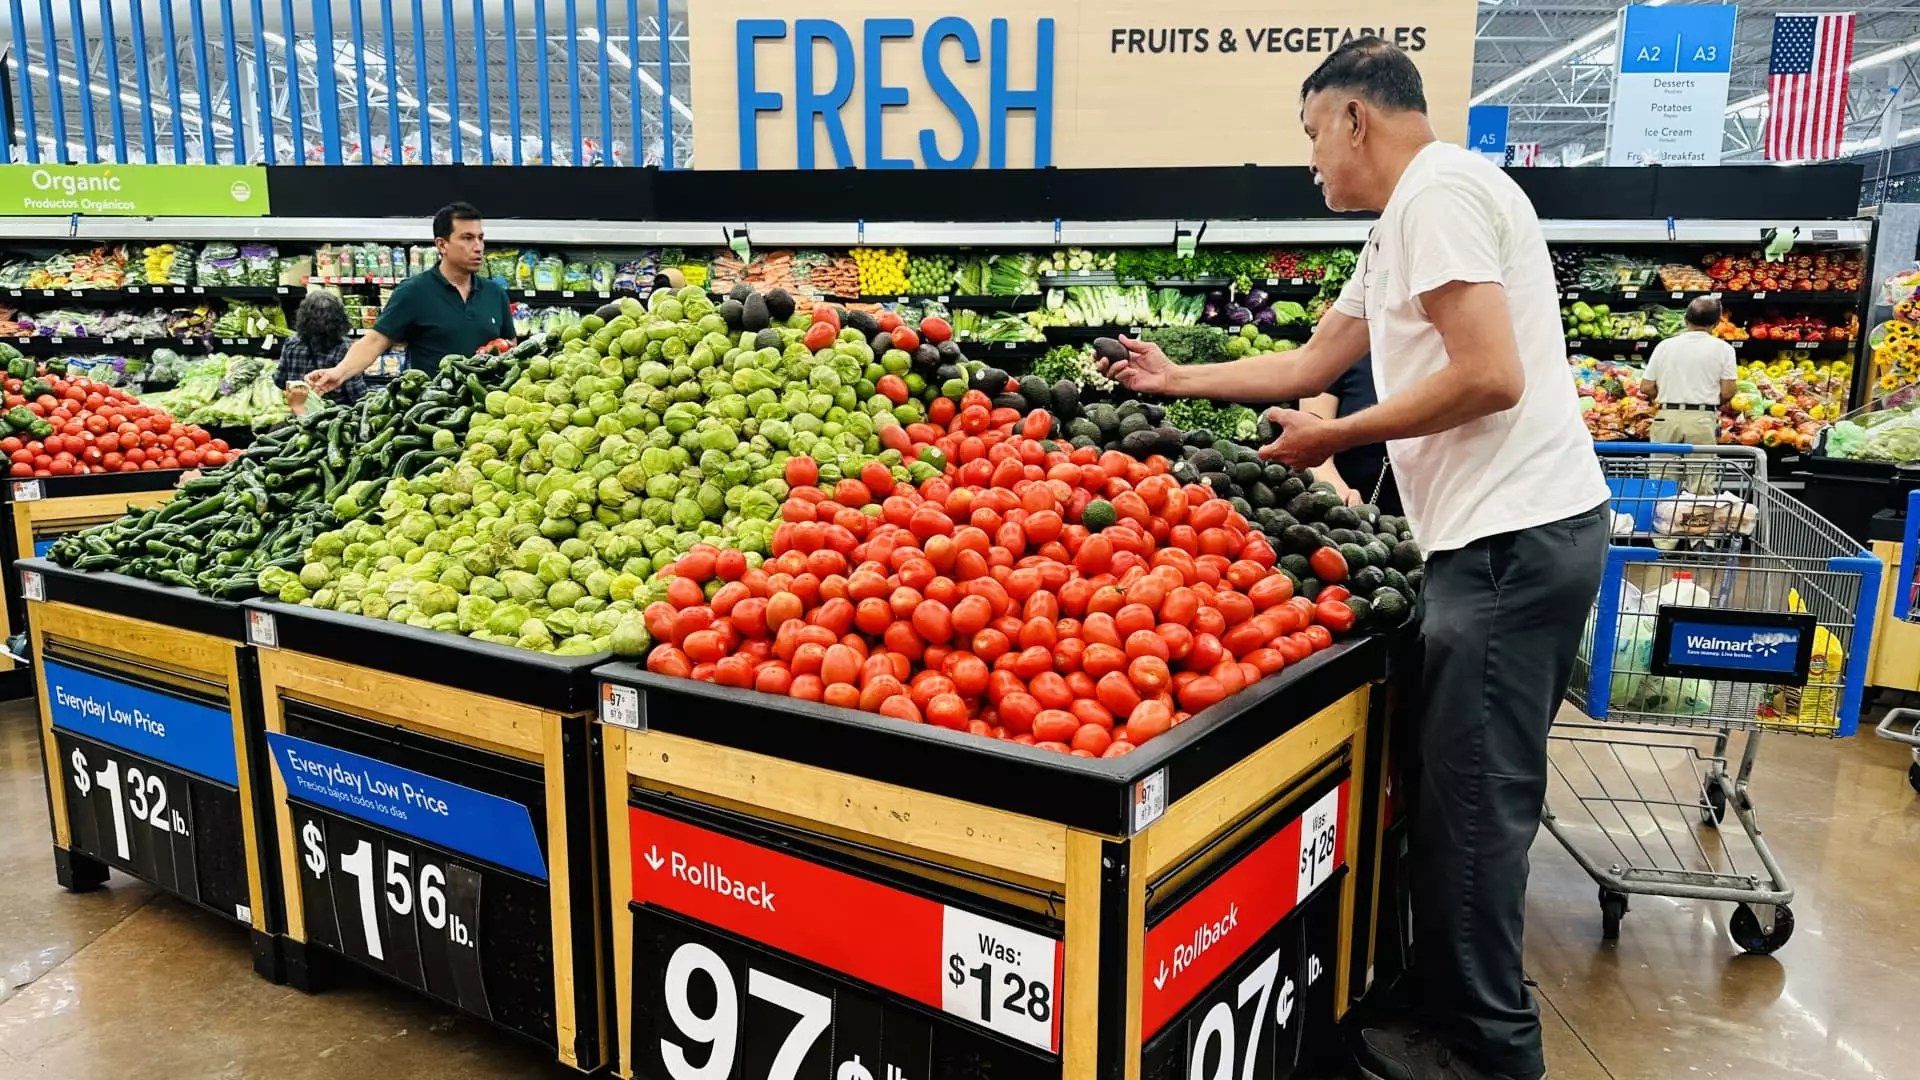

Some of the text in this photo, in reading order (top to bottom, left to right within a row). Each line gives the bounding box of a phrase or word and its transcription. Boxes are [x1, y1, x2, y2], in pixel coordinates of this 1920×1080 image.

[1111, 28, 1209, 53] FRUITS
[1218, 29, 1237, 52] &
[1636, 46, 1717, 62] A2 A3
[736, 17, 1055, 169] FRESH
[1653, 78, 1695, 88] Desserts
[1651, 103, 1692, 112] Potatoes
[1479, 133, 1496, 145] A5
[1644, 127, 1692, 137] Ice Cream
[32, 169, 121, 195] Organic
[24, 198, 78, 209] Productos
[1687, 635, 1753, 653] Walmart
[56, 685, 166, 737] Everyday Low Price
[287, 749, 449, 816] Everyday Low Price
[296, 775, 328, 795] Precios
[327, 784, 350, 802] bajos
[350, 793, 375, 809] todos
[375, 799, 389, 814] los
[172, 809, 190, 837] lb.
[671, 852, 776, 912] Rollback
[449, 913, 474, 949] lb.
[1172, 902, 1239, 978] Rollback
[978, 932, 1021, 966] Was:
[1307, 953, 1323, 987] lb.
